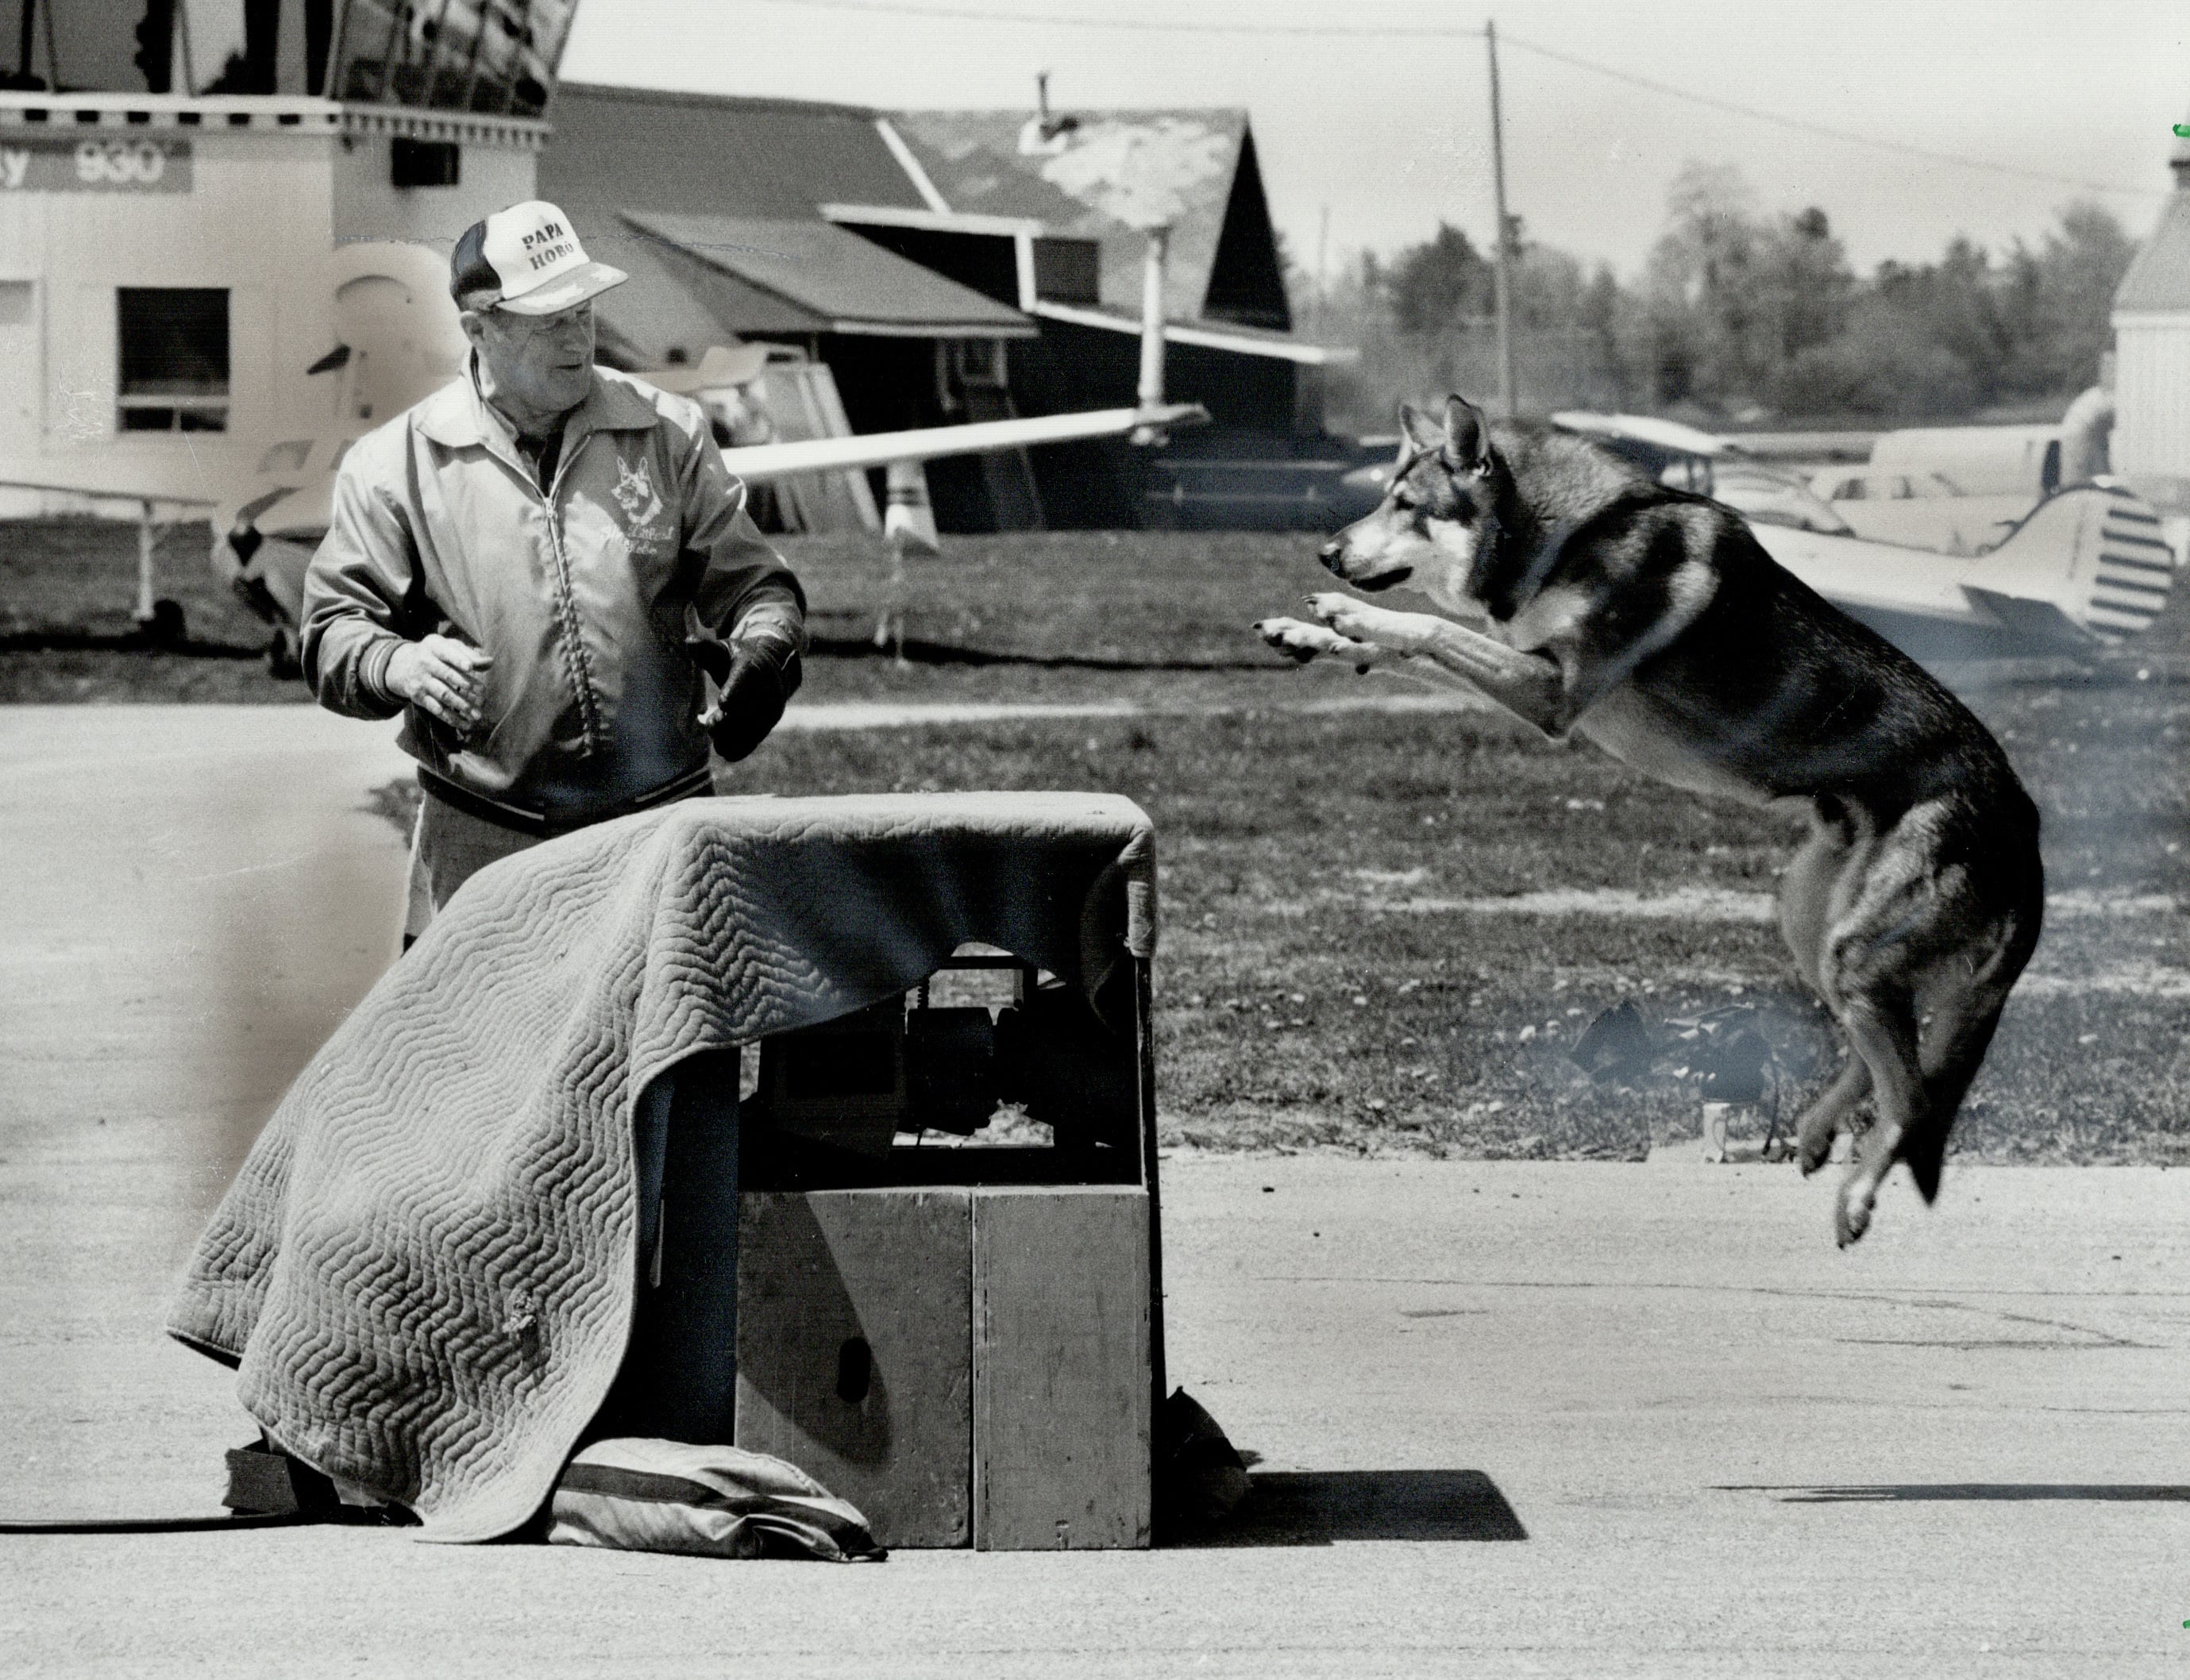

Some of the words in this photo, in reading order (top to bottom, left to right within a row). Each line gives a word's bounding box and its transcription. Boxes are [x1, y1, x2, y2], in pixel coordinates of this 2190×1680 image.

[0, 148, 30, 188] y
[75, 141, 164, 183] 930
[522, 222, 564, 250] PAPA
[530, 242, 574, 270] HOBO
